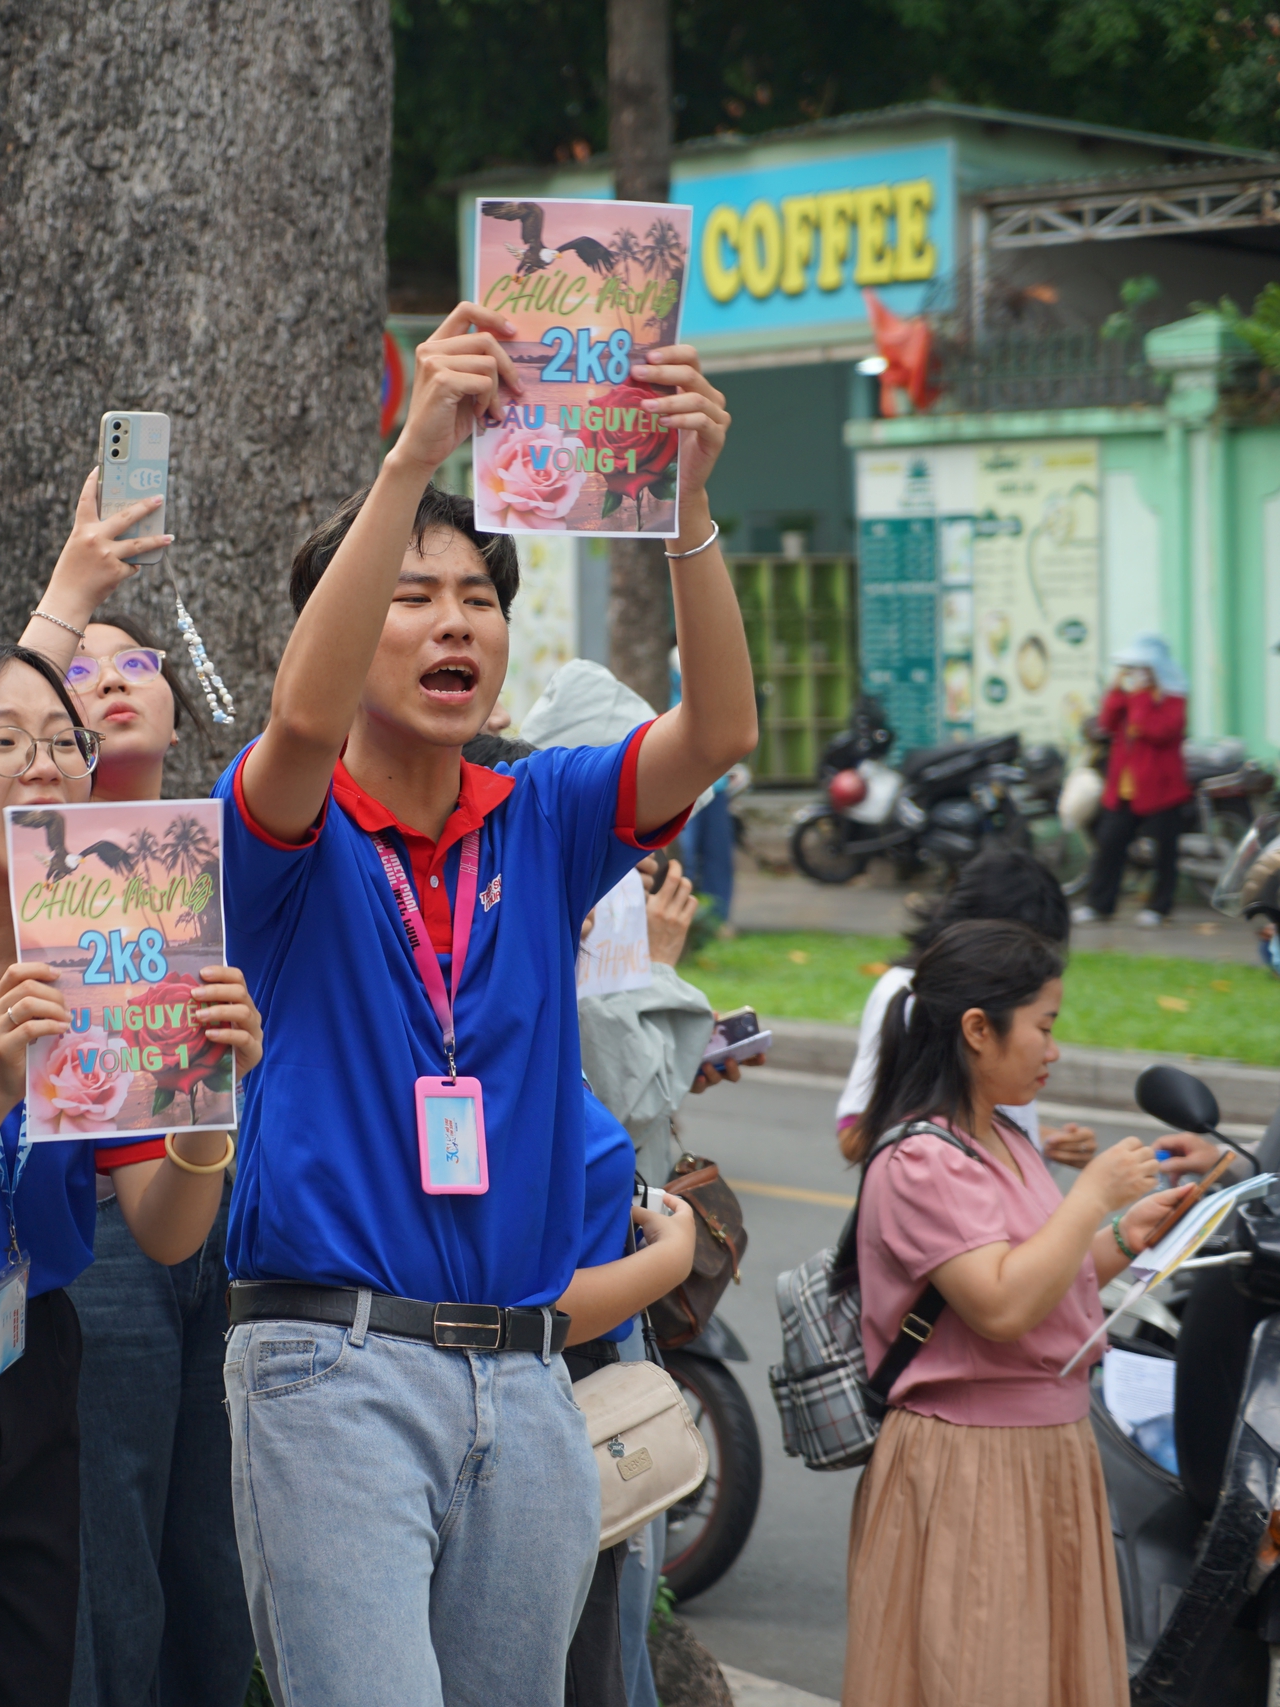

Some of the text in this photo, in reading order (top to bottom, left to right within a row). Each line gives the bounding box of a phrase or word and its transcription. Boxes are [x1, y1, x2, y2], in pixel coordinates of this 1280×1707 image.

[701, 178, 935, 303] COFFEE
[540, 326, 632, 385] 2k8
[624, 449, 637, 474] 1
[78, 927, 169, 986] 2k8
[174, 1043, 190, 1070] 1
